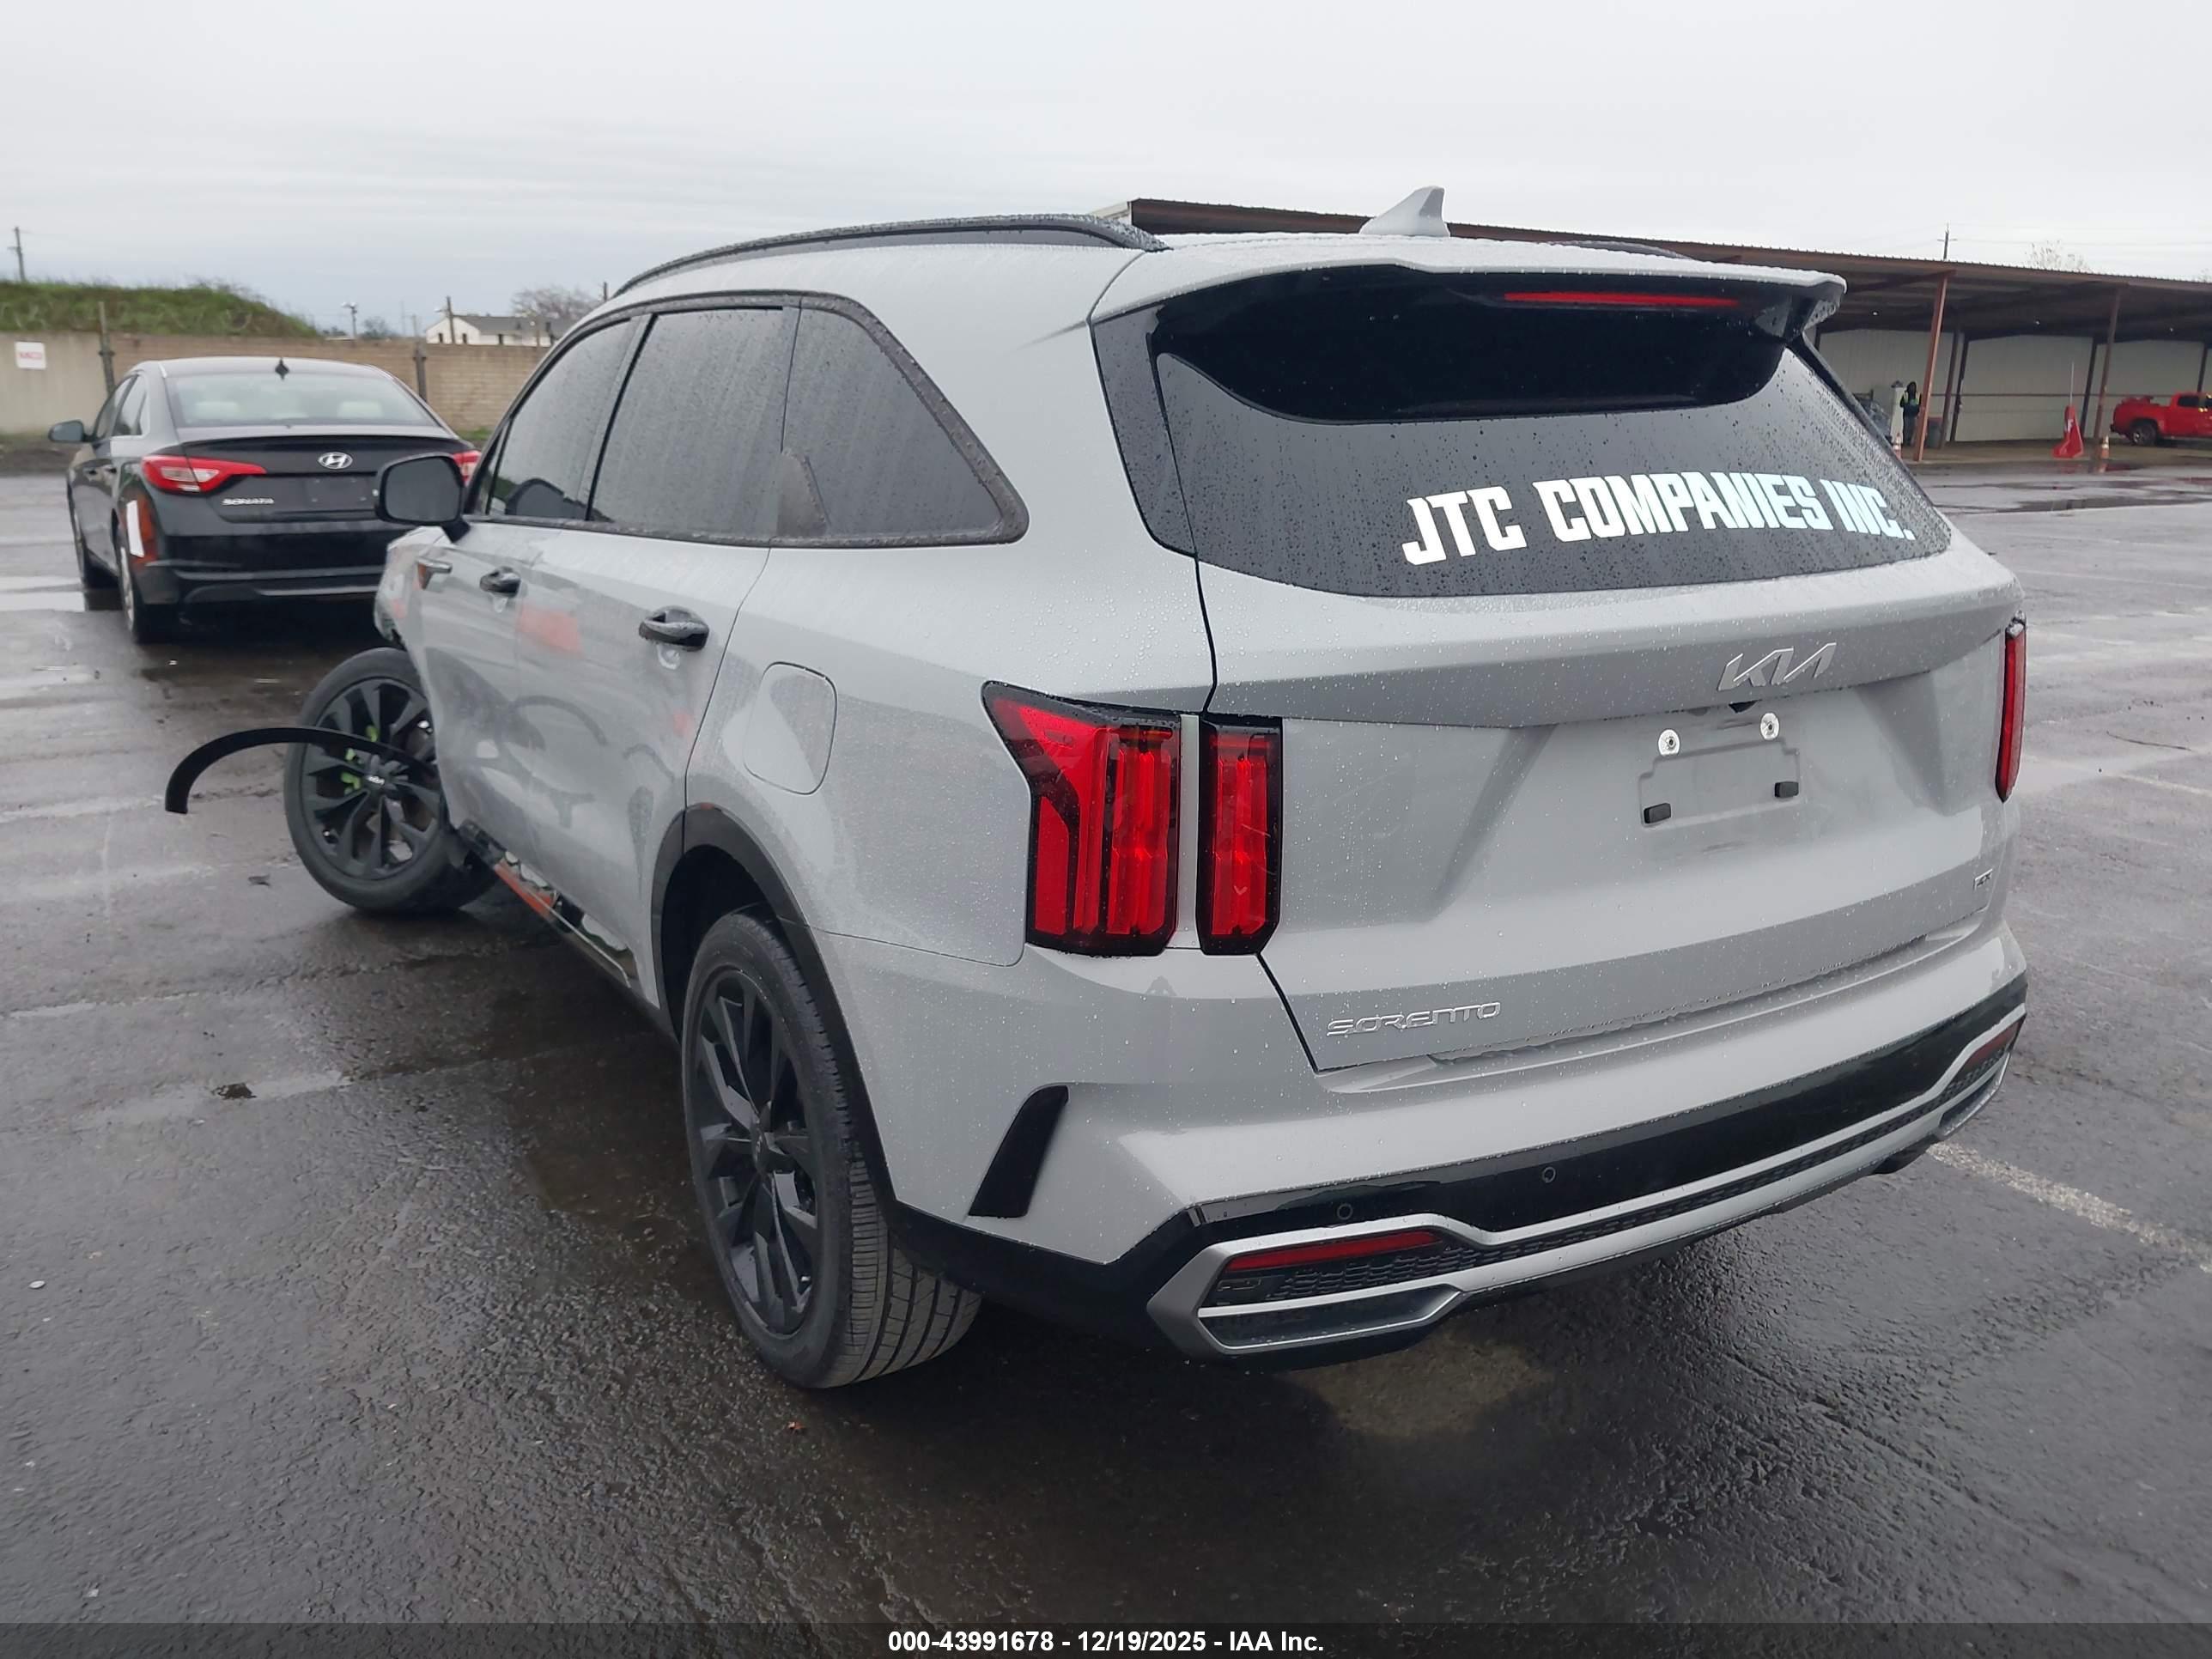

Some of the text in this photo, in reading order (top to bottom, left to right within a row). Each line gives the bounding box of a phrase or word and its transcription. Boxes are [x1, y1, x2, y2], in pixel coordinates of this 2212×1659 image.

[1401, 471, 1916, 566] JTC COMPANIES INC.
[1326, 1001, 1501, 1037] SORENTO
